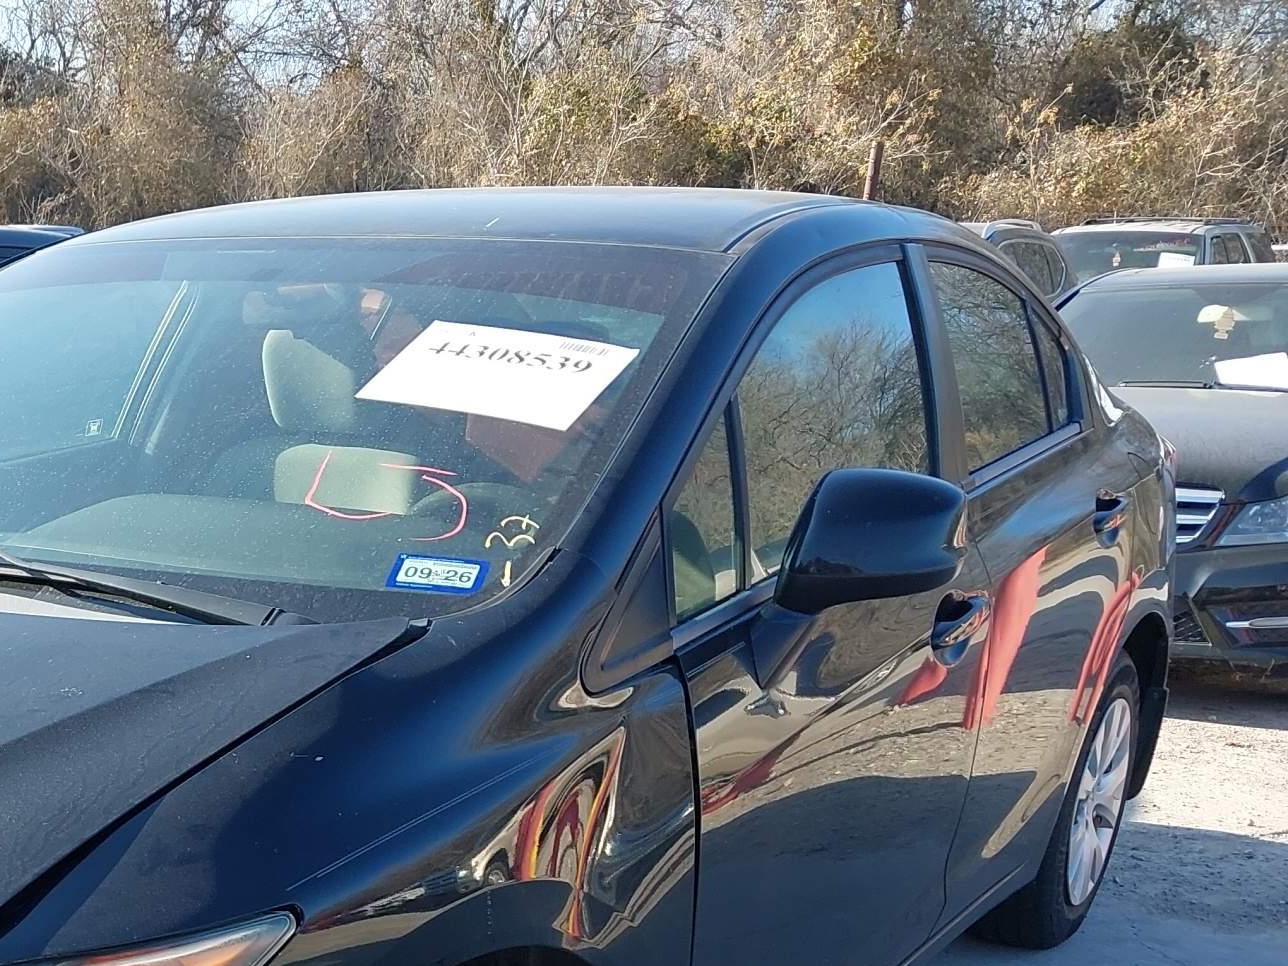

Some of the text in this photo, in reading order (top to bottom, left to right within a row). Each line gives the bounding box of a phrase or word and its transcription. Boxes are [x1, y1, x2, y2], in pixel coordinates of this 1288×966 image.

[429, 341, 593, 373] 44308539
[404, 566, 432, 579] 09
[443, 569, 473, 583] 26
